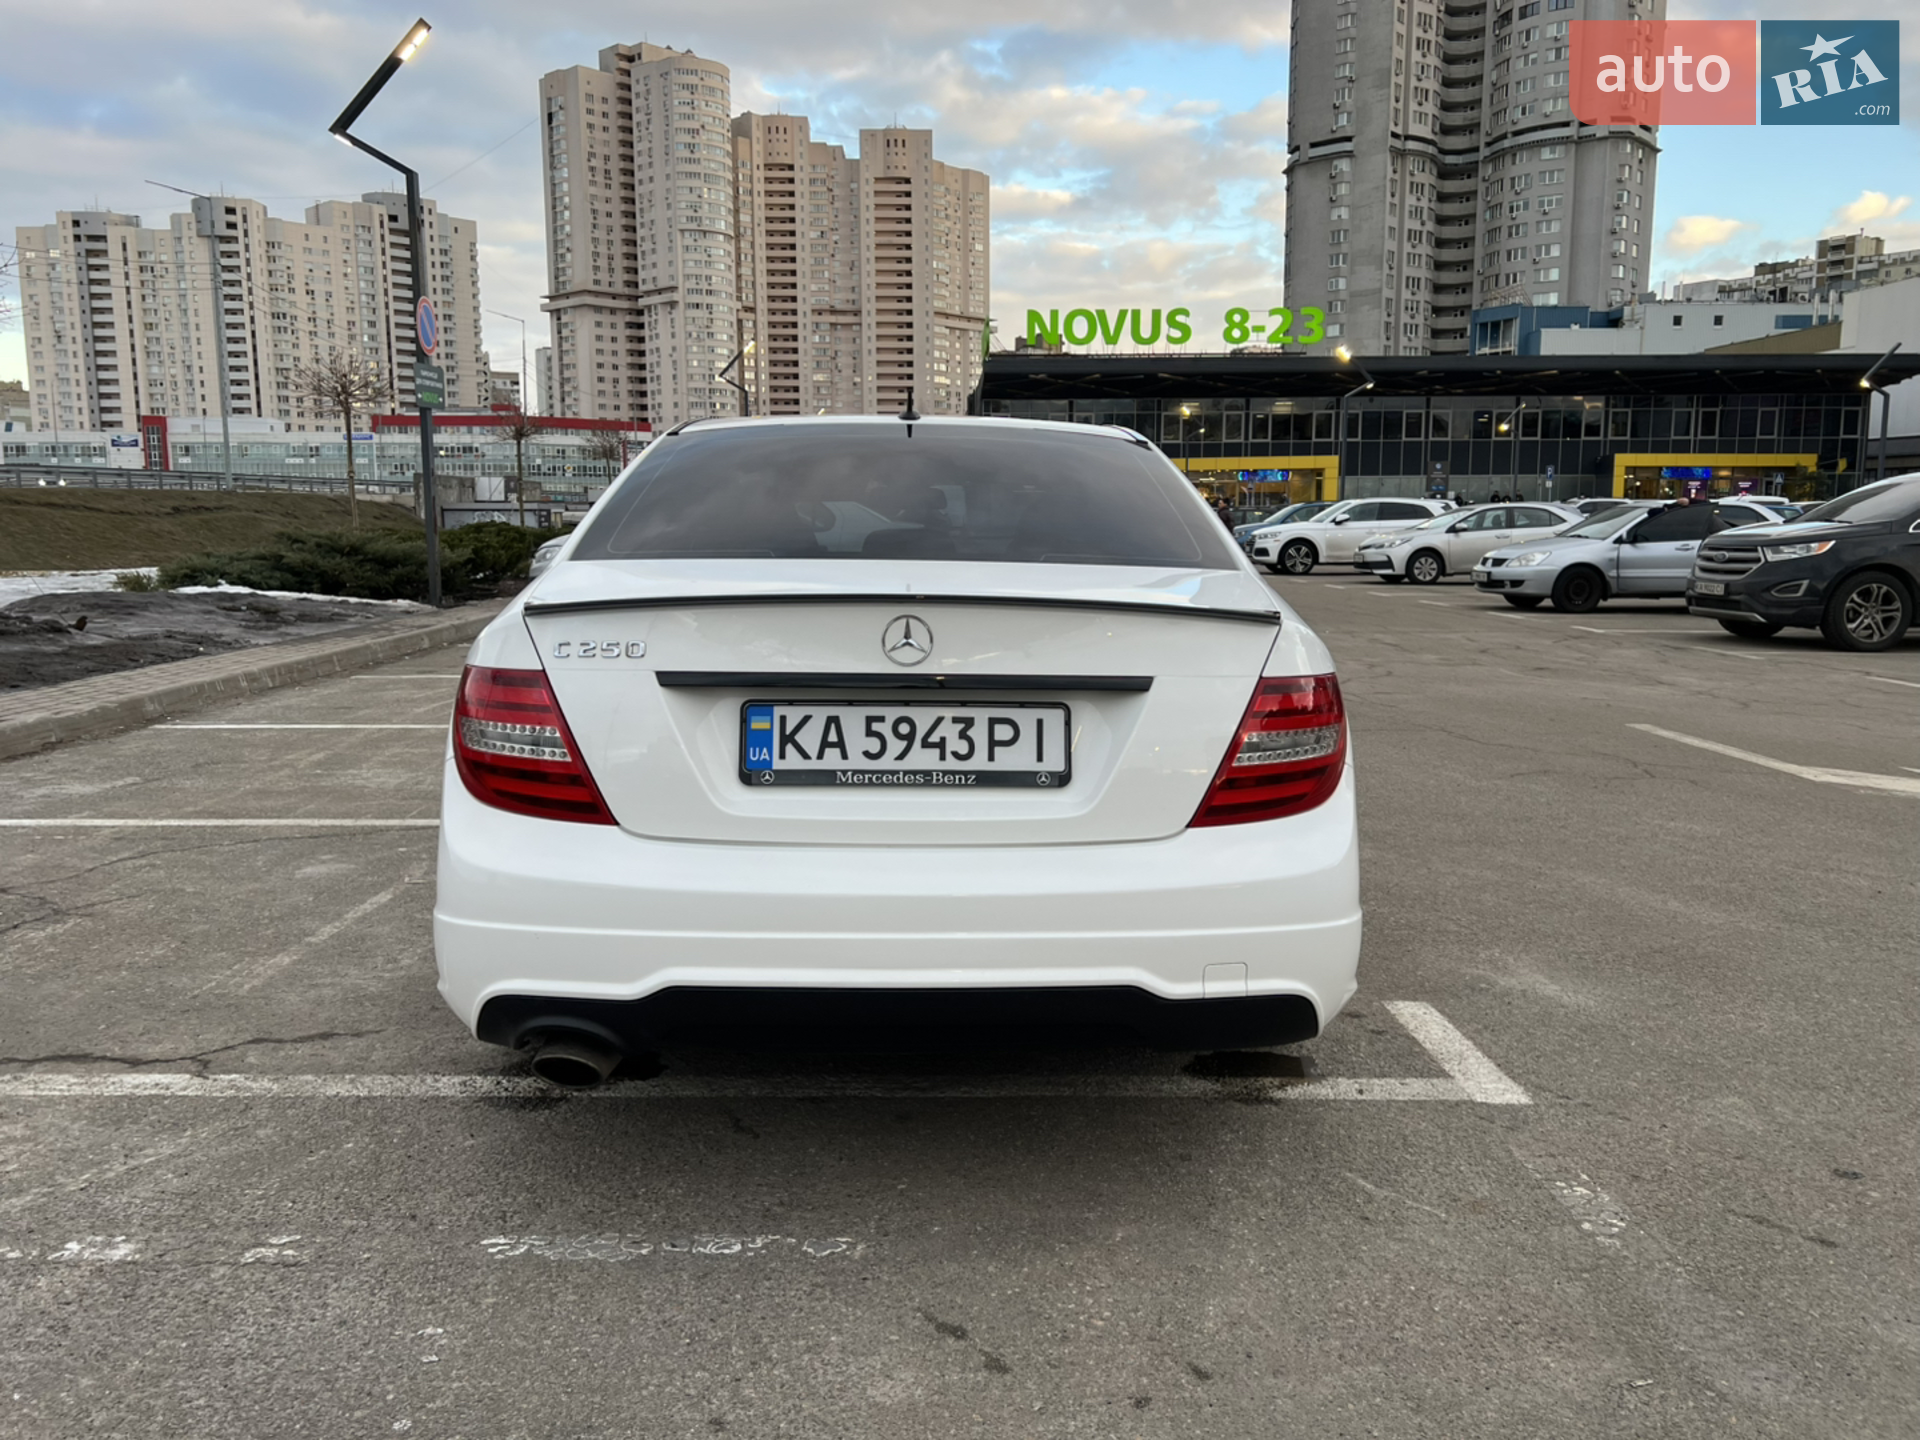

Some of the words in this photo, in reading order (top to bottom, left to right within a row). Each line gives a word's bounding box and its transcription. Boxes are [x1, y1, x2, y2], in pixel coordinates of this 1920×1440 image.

[1026, 308, 1192, 346] NOVUS
[1223, 306, 1326, 345] 8-23
[554, 640, 571, 658] C
[578, 640, 647, 658] 250
[779, 715, 849, 760] KA
[862, 716, 976, 761] 5943
[987, 717, 1044, 763] PI
[749, 748, 770, 762] UA
[836, 771, 976, 785] Mercedes-Benz
